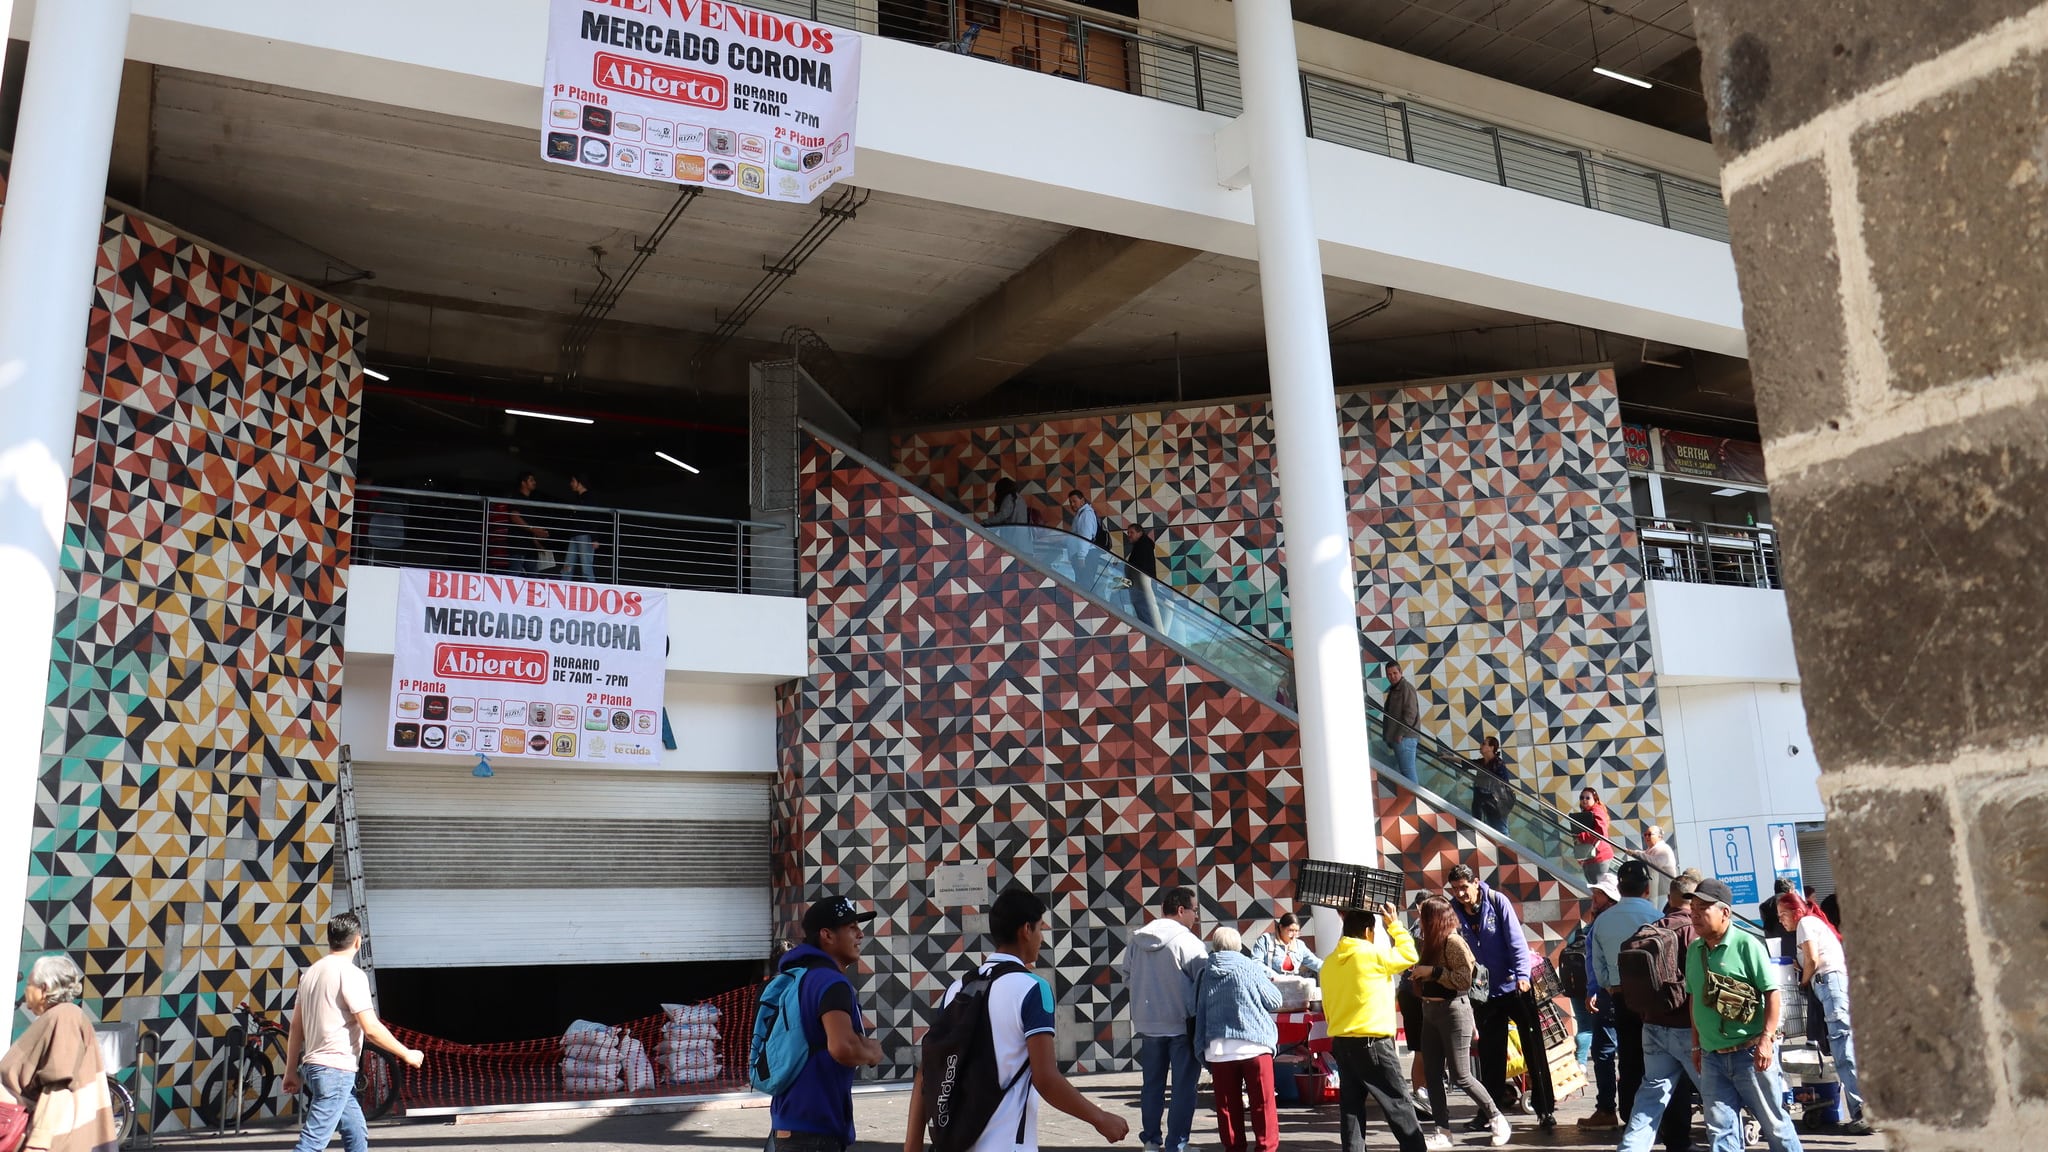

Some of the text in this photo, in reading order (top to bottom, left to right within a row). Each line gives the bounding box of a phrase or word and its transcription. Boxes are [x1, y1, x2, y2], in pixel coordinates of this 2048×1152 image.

[585, 0, 835, 54] NVENIDOS
[580, 10, 833, 93] MERCADO CORONA
[601, 61, 721, 104] Abierto
[568, 86, 609, 106] Planta
[733, 82, 788, 105] HORARIO
[733, 96, 749, 111] DE
[752, 100, 780, 117] 7AM
[794, 110, 820, 129] 7PM
[789, 130, 825, 148] Planta
[1677, 446, 1709, 460] BERTHA
[427, 570, 643, 617] BIENVENIDOS
[424, 606, 642, 652] MERCADO CORONA
[440, 650, 542, 679] Abierto
[553, 655, 600, 671] HORARIO
[412, 680, 446, 694] Planta
[552, 670, 567, 682] DE
[569, 671, 593, 685] 7AM
[605, 674, 629, 688] 7PM
[600, 693, 632, 707] Planta
[624, 746, 651, 756] cuida
[1719, 875, 1753, 883] HOMBRES
[937, 1054, 958, 1128] adidas
